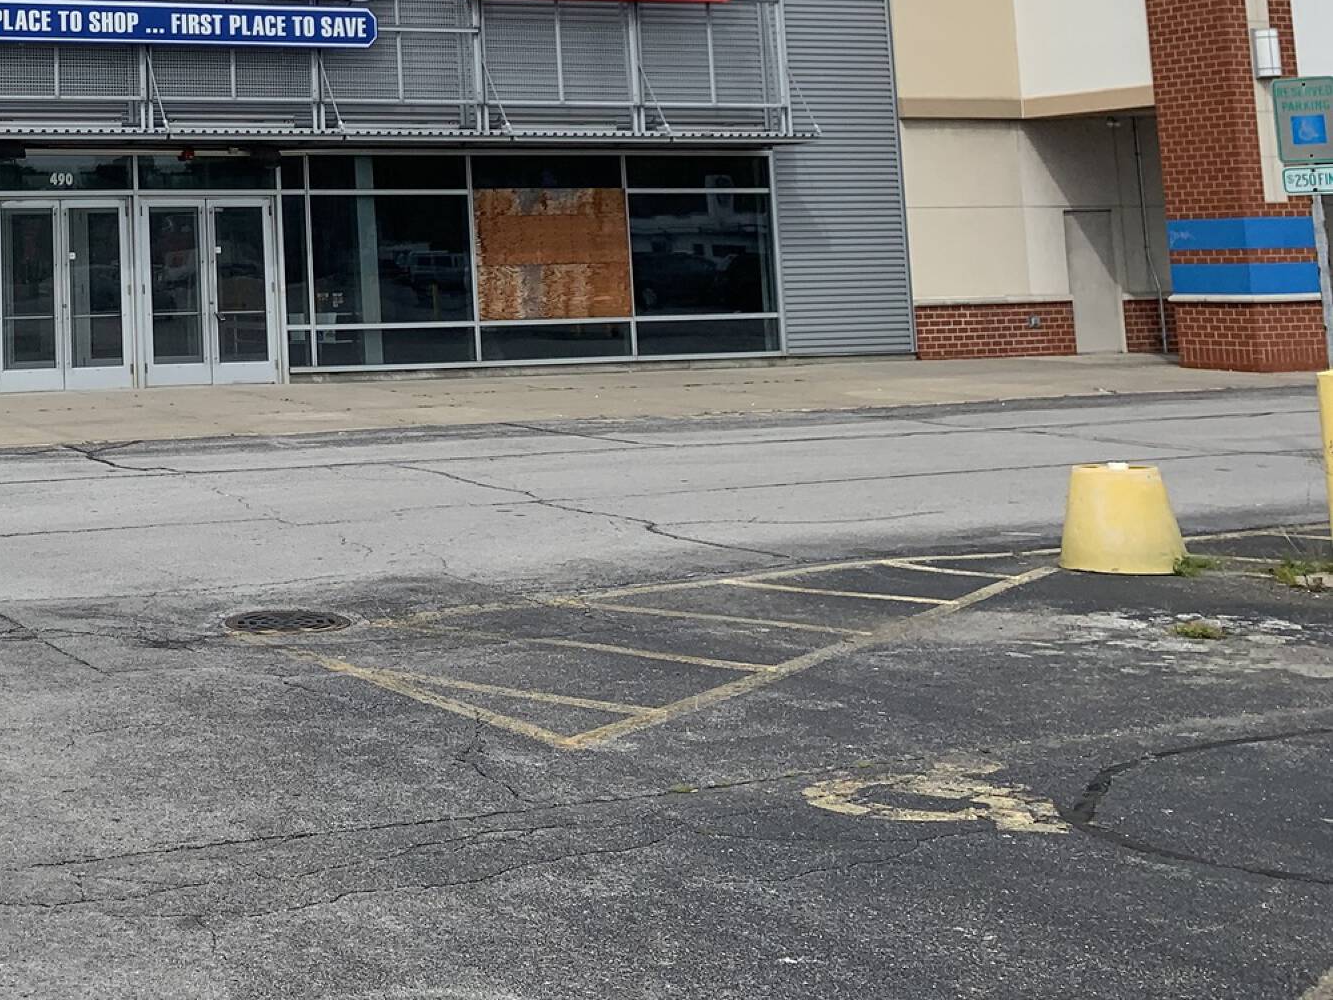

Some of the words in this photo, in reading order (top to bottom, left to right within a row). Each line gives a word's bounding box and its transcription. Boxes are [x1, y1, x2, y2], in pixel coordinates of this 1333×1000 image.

[58, 10, 83, 33] TO
[88, 11, 139, 35] SHOP
[171, 13, 224, 36] FIRST
[229, 15, 287, 37] PLACE
[292, 16, 316, 38] TO
[320, 16, 367, 39] SAVE
[1276, 85, 1332, 97] RESERVED
[1282, 101, 1330, 111] PARKING
[49, 172, 73, 186] 490
[1286, 173, 1316, 187] $250
